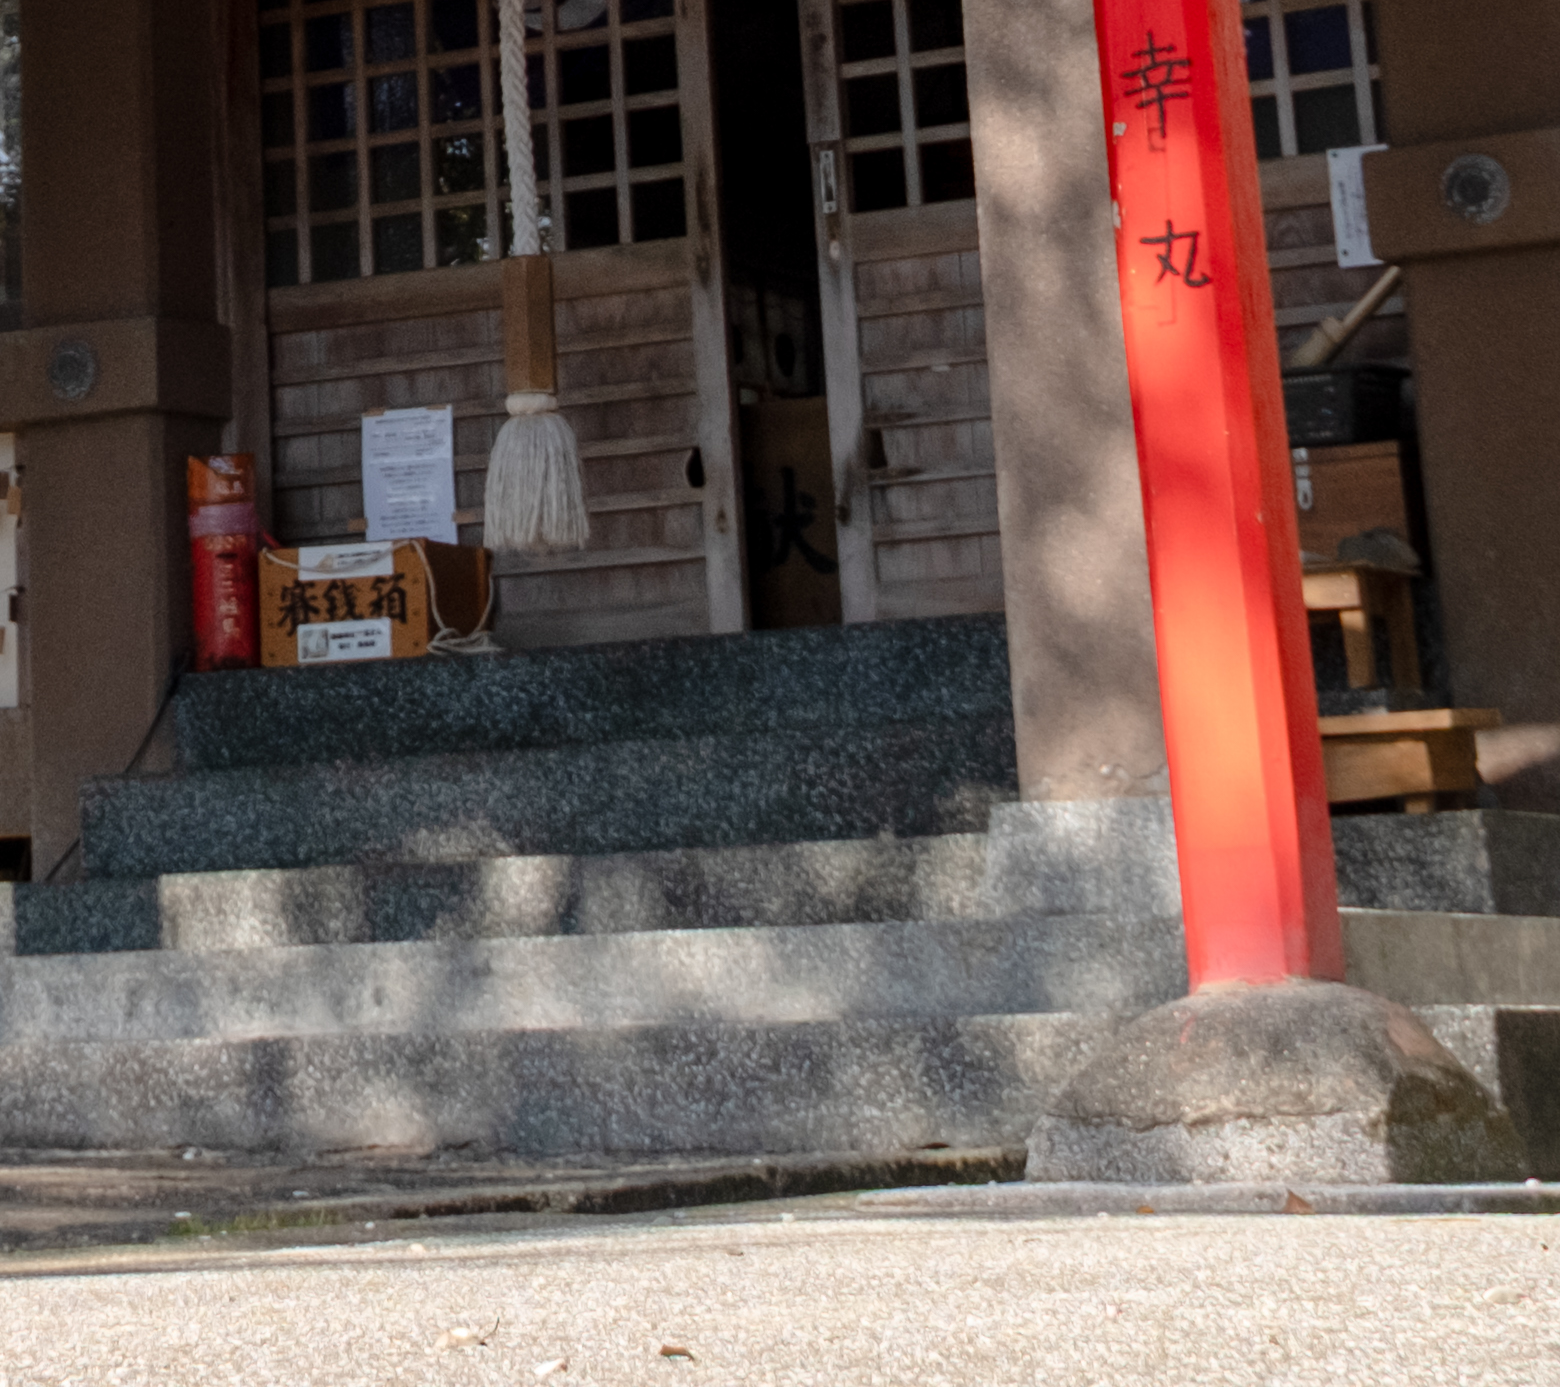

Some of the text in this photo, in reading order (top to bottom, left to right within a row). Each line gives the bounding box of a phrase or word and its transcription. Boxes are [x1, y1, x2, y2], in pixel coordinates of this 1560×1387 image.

[1121, 31, 1211, 289] 幸丸
[277, 574, 408, 637] 賽銭箱
